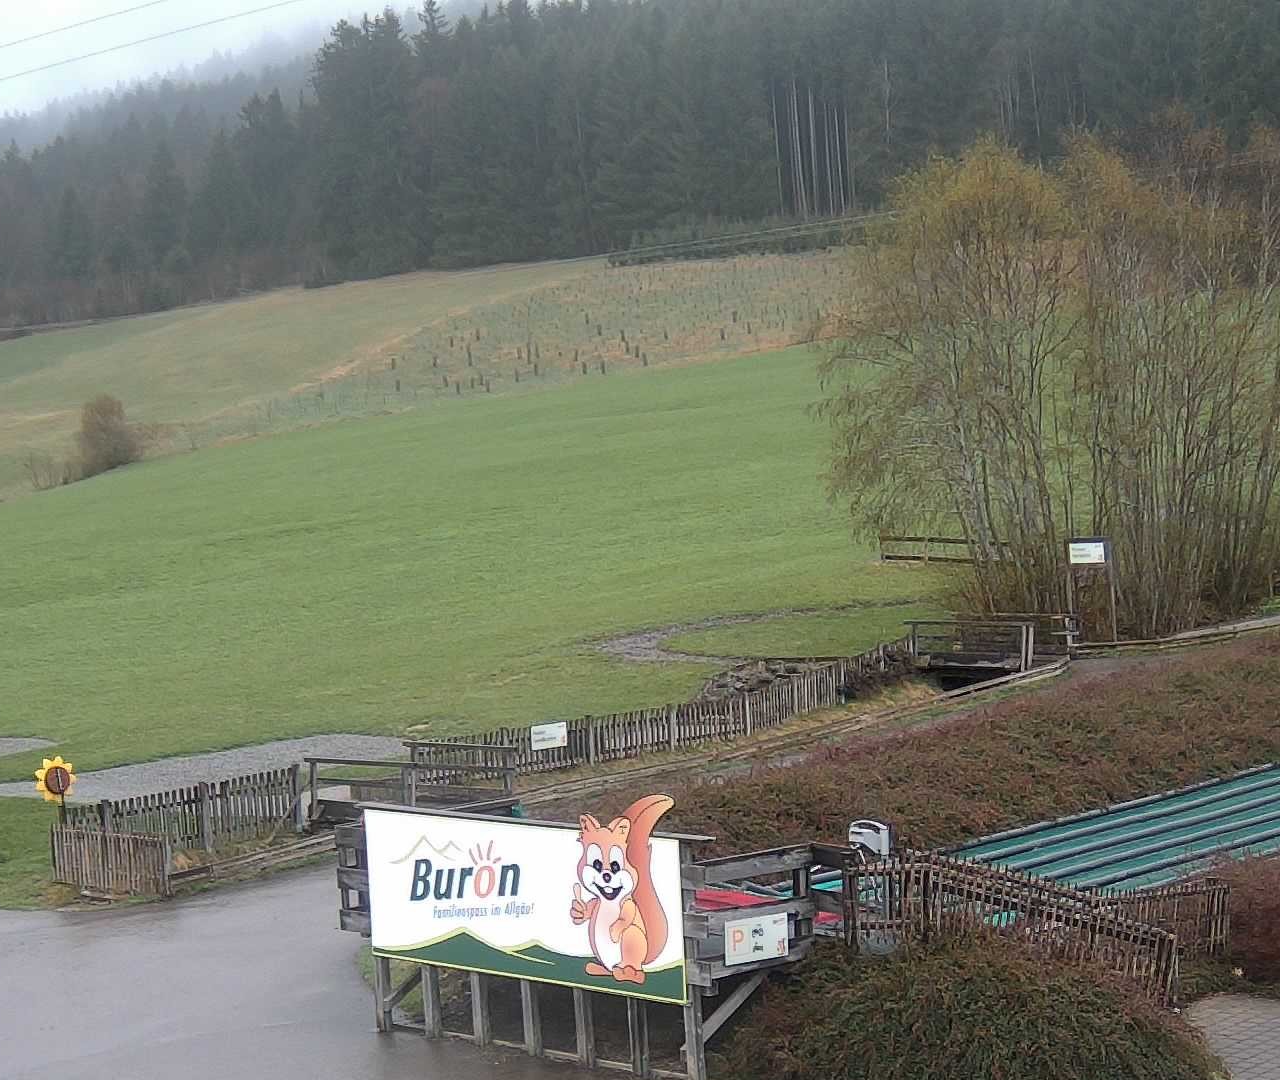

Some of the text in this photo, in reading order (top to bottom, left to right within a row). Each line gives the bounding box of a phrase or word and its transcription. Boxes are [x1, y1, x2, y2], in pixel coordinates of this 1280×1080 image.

[410, 858, 521, 901] Buron
[491, 904, 501, 916] im
[732, 928, 745, 952] P
